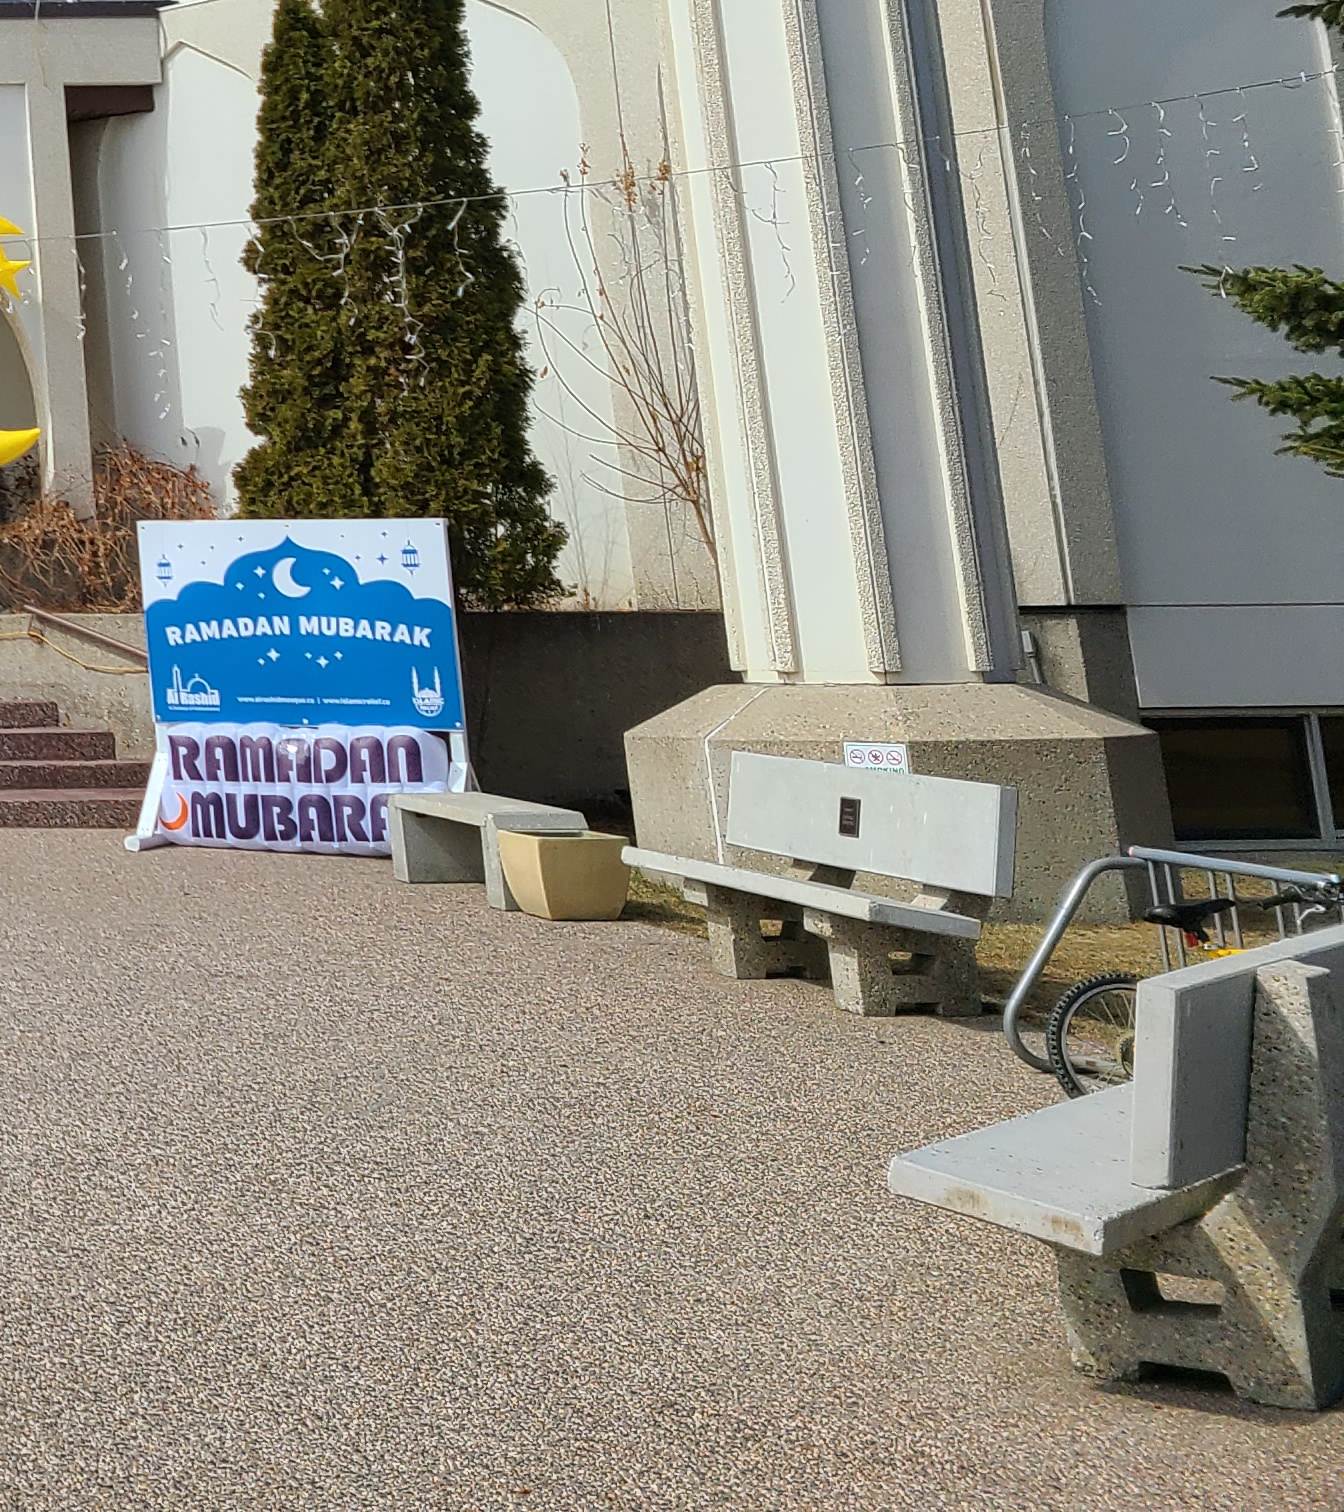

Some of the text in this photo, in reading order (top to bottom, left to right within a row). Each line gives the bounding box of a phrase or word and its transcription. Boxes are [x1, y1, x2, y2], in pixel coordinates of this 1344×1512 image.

[164, 614, 433, 649] RAMADAN MUBARAK
[167, 734, 423, 785] RAMADAN
[190, 790, 389, 843] MUBARA
